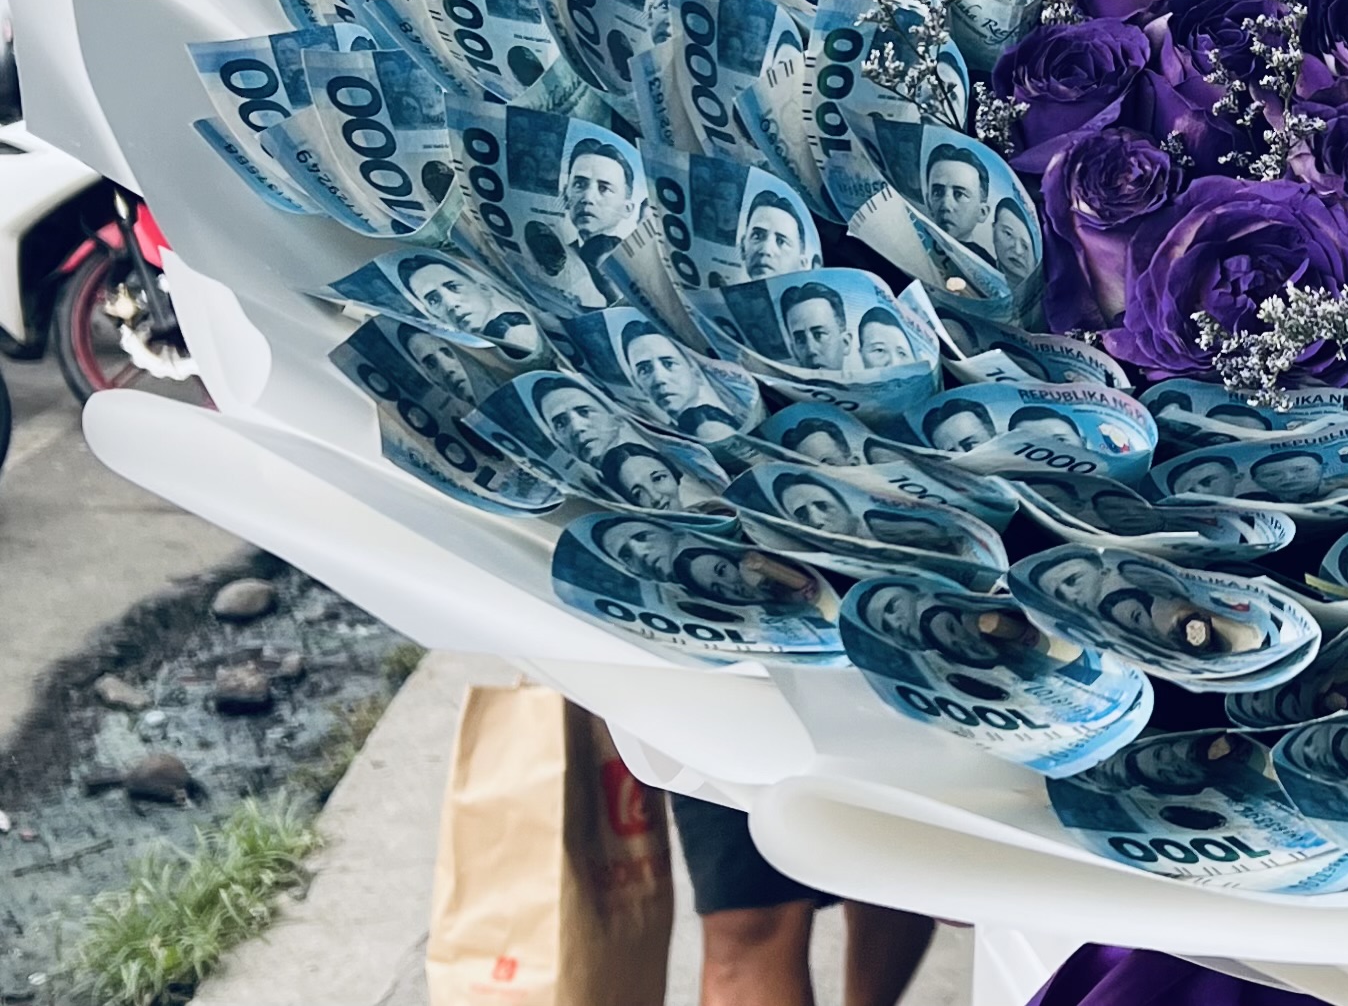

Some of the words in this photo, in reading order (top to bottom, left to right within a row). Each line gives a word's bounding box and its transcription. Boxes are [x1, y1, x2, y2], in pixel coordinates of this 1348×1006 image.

[680, 1, 736, 151] 1000
[815, 27, 864, 158] 1000
[326, 76, 428, 232] 1000
[463, 126, 523, 255] 1000
[656, 176, 702, 290] 000
[357, 362, 502, 493] 1000
[1018, 389, 1110, 403] REPUBLIKA
[1014, 442, 1097, 474] 1000
[594, 597, 757, 646] 1000
[895, 684, 1051, 732] 1000
[1108, 834, 1272, 864] 1000
